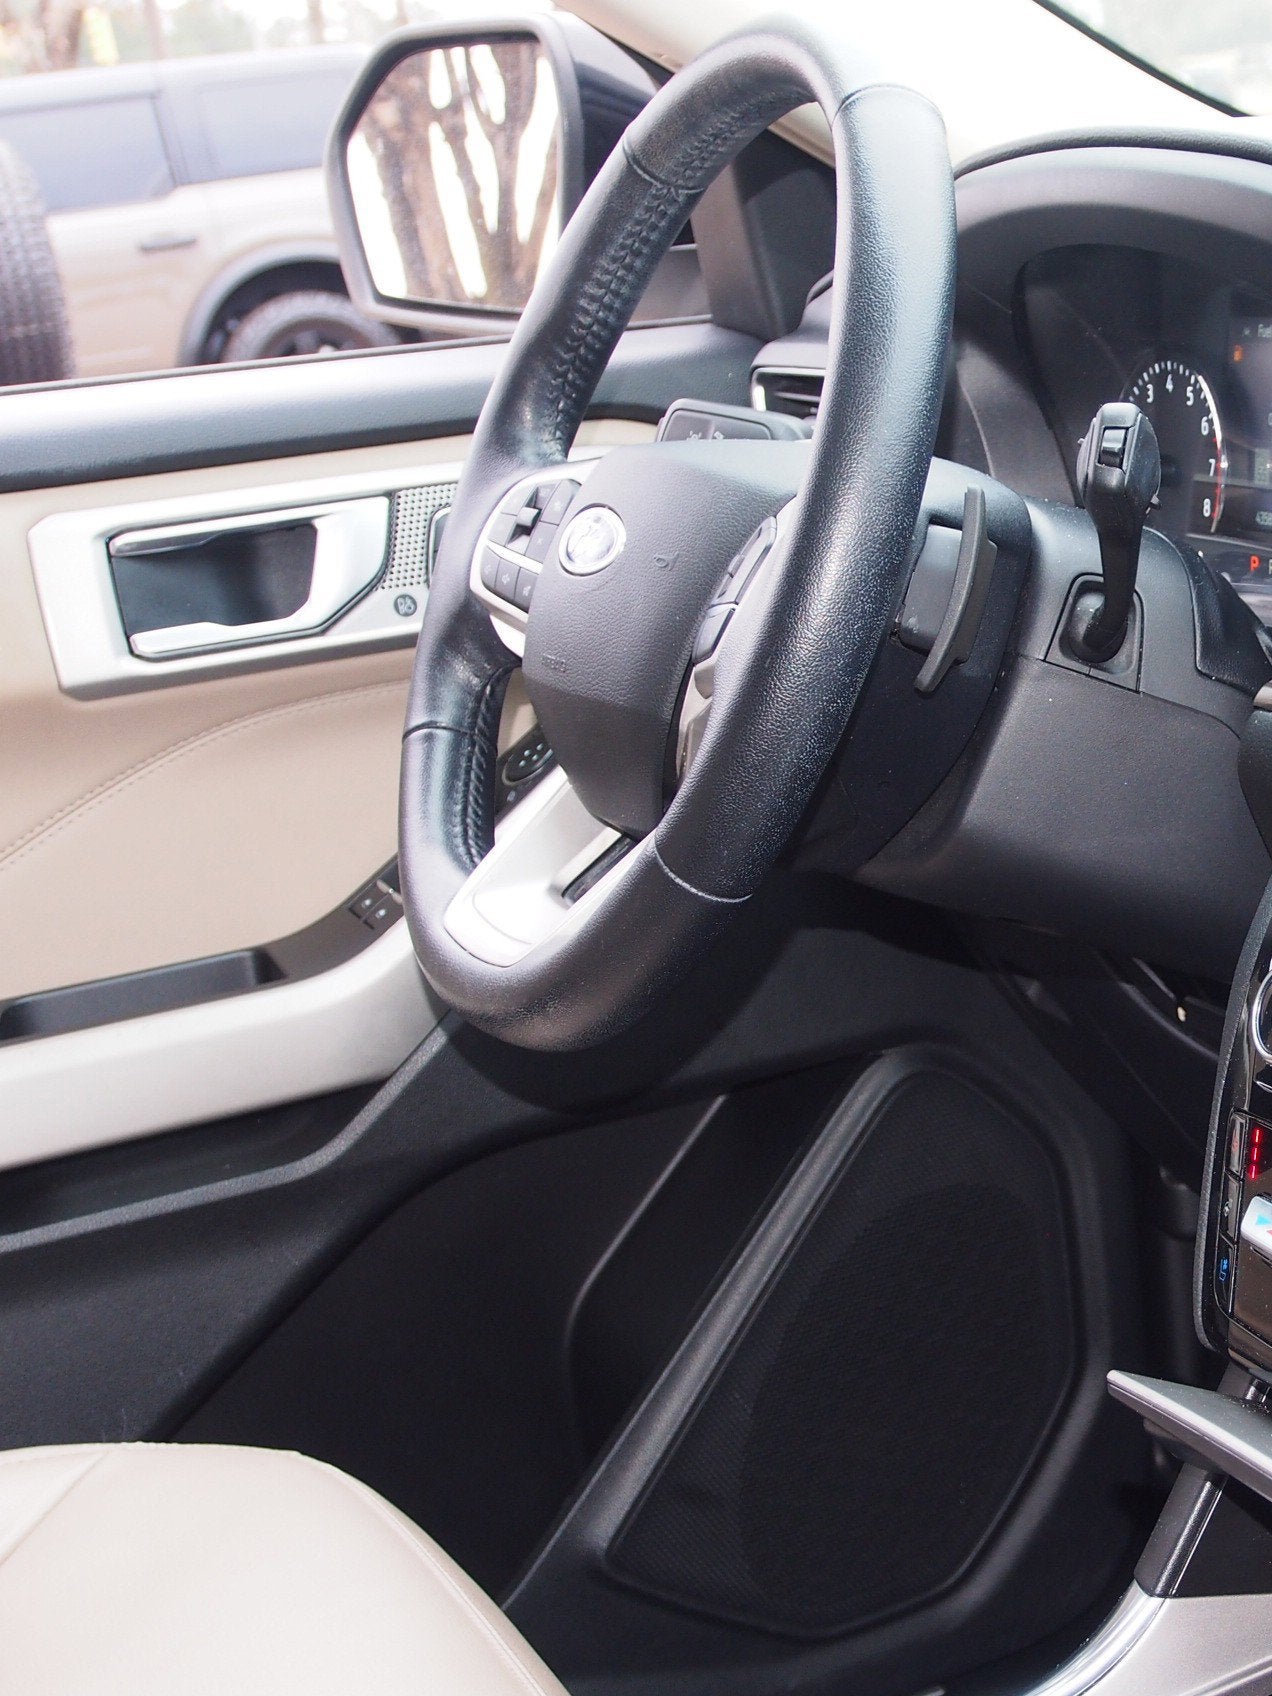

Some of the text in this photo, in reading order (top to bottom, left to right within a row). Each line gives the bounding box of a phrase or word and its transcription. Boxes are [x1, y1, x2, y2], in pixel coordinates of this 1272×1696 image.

[1165, 375, 1173, 392] 4
[1146, 384, 1154, 403] 3
[1186, 387, 1194, 406] 5
[1201, 416, 1209, 436] 6
[1208, 458, 1216, 477] 7
[1203, 498, 1211, 517] 8
[1250, 555, 1261, 573] P
